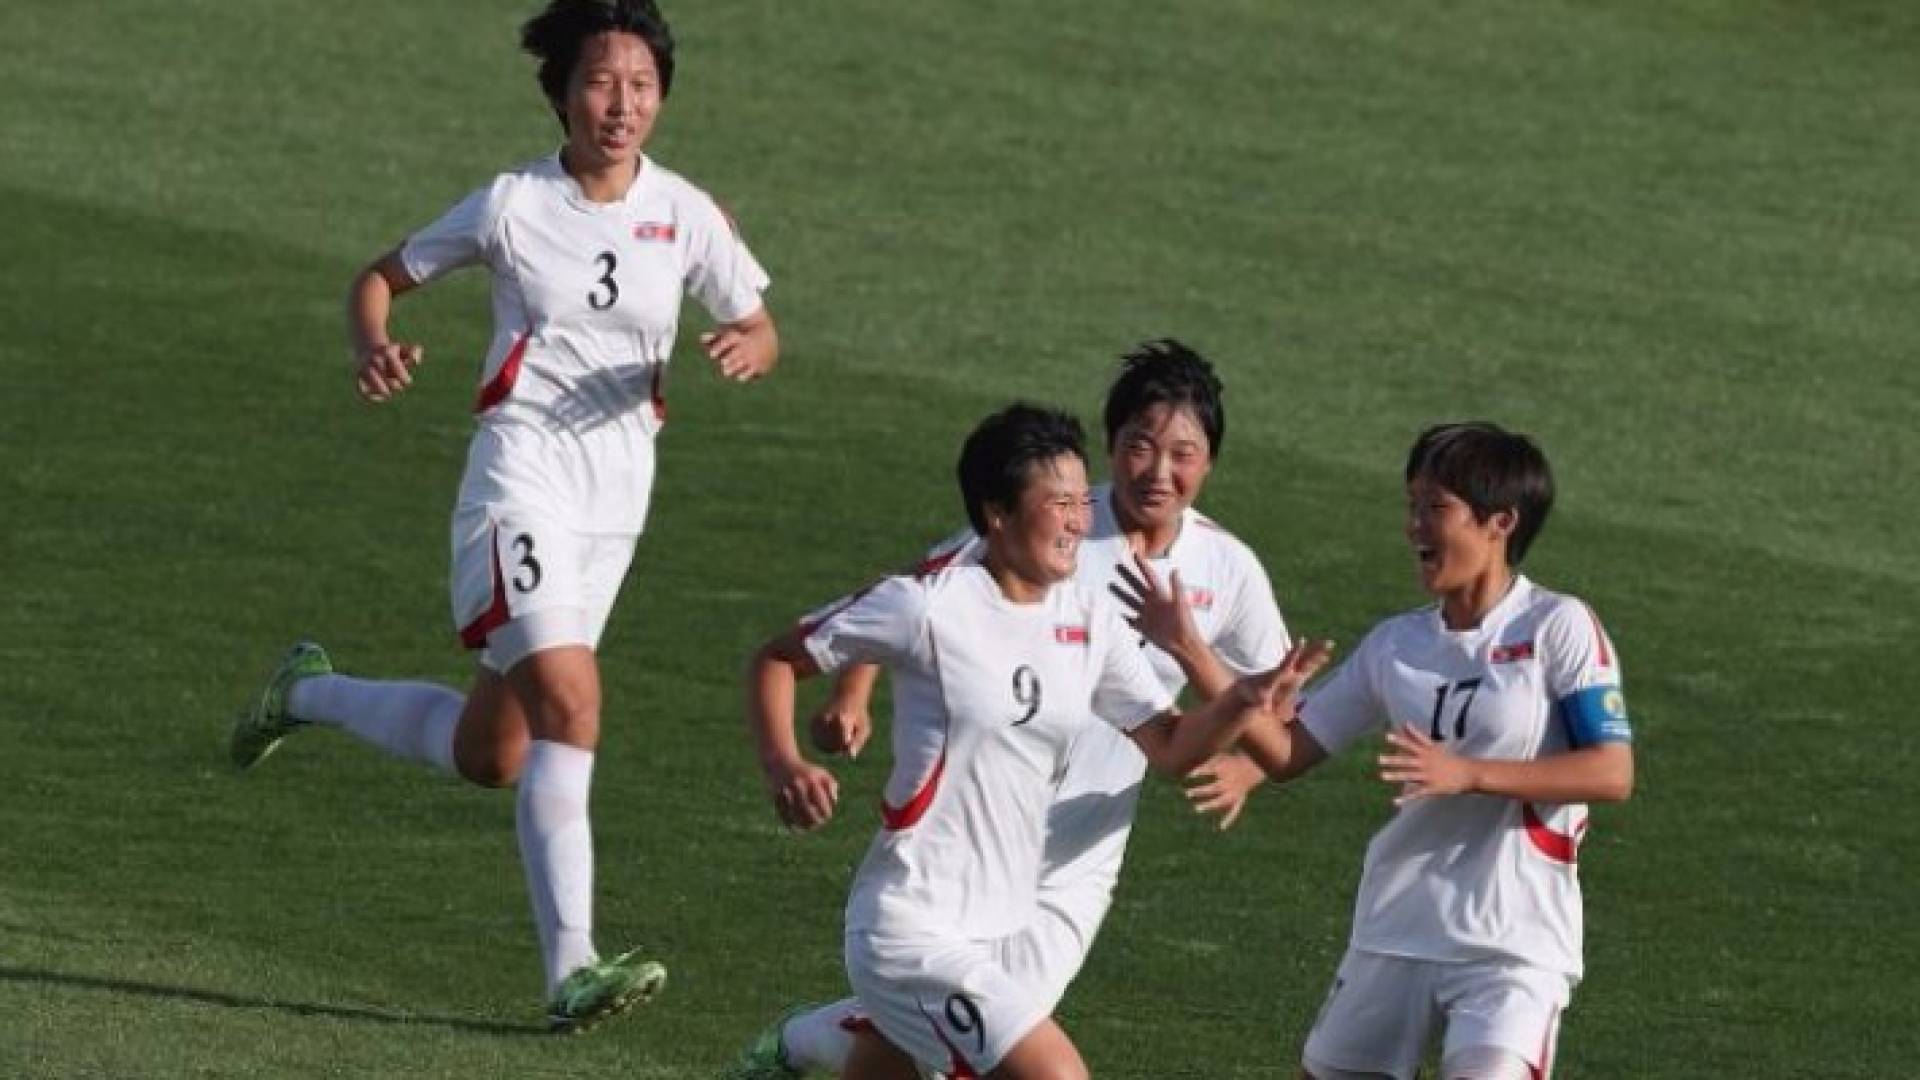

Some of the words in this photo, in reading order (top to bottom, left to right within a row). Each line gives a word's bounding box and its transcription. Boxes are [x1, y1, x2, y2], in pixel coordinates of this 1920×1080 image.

[588, 251, 619, 311] 3
[512, 532, 542, 595] 3
[1010, 666, 1042, 728] 9
[1428, 675, 1485, 743] 17
[944, 991, 986, 1054] 9
